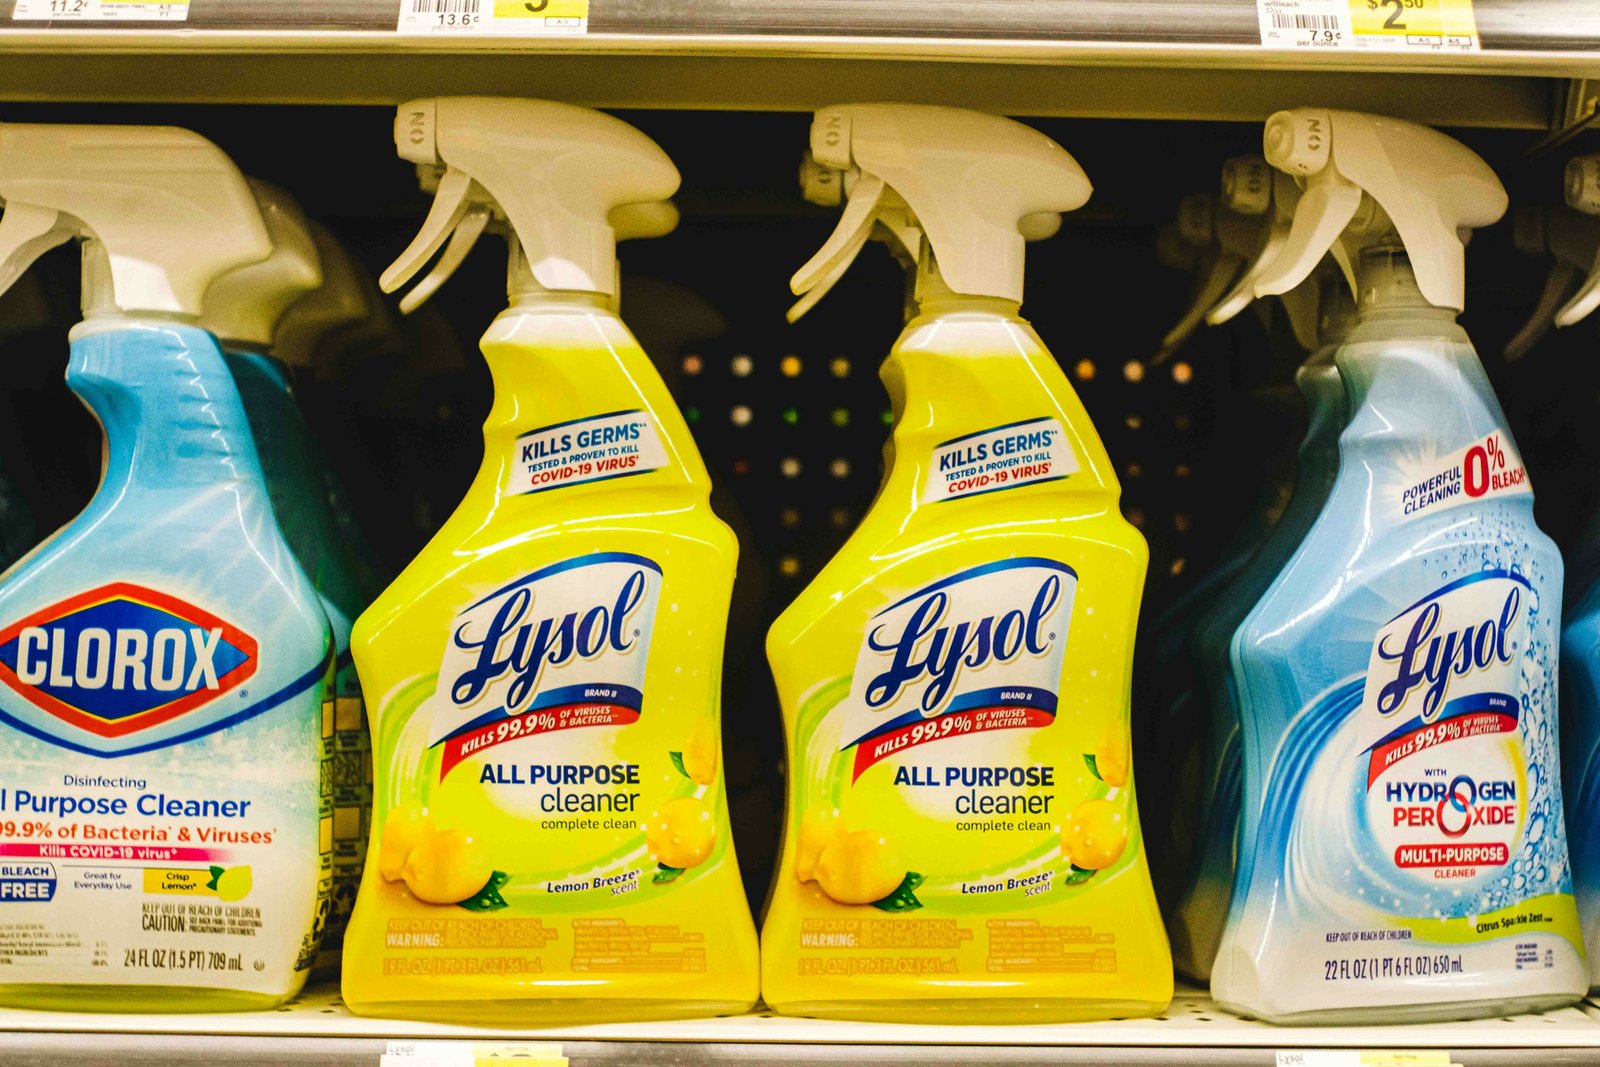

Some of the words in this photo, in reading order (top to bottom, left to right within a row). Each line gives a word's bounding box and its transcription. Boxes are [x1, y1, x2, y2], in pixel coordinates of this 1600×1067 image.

[521, 434, 571, 463] KILLS
[528, 458, 560, 473] TESTED
[570, 448, 606, 463] PROVEN
[608, 447, 620, 456] TO
[621, 444, 640, 454] KILL
[939, 443, 988, 472] KILLS
[531, 462, 593, 485] COVID-19
[945, 467, 977, 481] TESTED
[986, 457, 1020, 471] PROVEN
[1022, 454, 1033, 463] TO
[1034, 451, 1052, 461] KILL
[1463, 435, 1505, 498] 0%
[948, 471, 1008, 493] COVID-19
[1402, 466, 1462, 503] POWERFUL
[1404, 481, 1461, 515] CLEANING
[451, 570, 646, 711] Lysol
[865, 574, 1061, 713] Lysol
[16, 626, 224, 691] CLOROX
[1377, 586, 1521, 720] Lysol
[584, 689, 611, 698] BRAND
[1000, 691, 1026, 700] BRAND
[1489, 698, 1507, 707] BRAND
[560, 709, 573, 720] OF
[574, 705, 611, 717] VIRUSES
[976, 712, 988, 721] OF
[990, 708, 1026, 719] VIRUSES
[1462, 718, 1472, 727] OF
[1473, 715, 1499, 725] VIRUSES
[460, 731, 495, 758] KILLS
[496, 712, 556, 744] 99.9%
[874, 734, 909, 758] KILLS
[910, 715, 972, 746] 99.9%
[1385, 741, 1413, 766] KILLS
[1415, 721, 1461, 752] 99.9%
[63, 775, 147, 790] Disinfecting
[479, 764, 526, 785] ALL
[530, 764, 641, 785] PURPOSE
[893, 766, 940, 786] ALL
[945, 766, 1055, 787] PURPOSE
[1424, 768, 1447, 777] WITH
[15, 789, 128, 819] Purpose
[136, 793, 251, 818] Cleaner
[540, 787, 641, 813] cleaner
[955, 789, 1055, 814] cleaner
[1386, 775, 1516, 812] HYDROGEN
[541, 818, 600, 832] complete
[603, 818, 637, 830] clean
[956, 820, 1014, 832] complete
[1017, 820, 1051, 831] clean
[1393, 793, 1516, 838] PEROXIDE
[0, 821, 53, 841] 9.9%
[57, 823, 78, 840] of
[178, 827, 191, 842] &
[39, 844, 66, 857] Kills
[69, 845, 134, 858] COVID-19
[1400, 846, 1504, 864] MULTI-PURPOSE
[1, 866, 49, 876] BLEACH
[83, 872, 107, 881] Great
[109, 872, 122, 881] for
[166, 872, 190, 882] Crisp
[1434, 868, 1476, 879] CLEANER
[1, 882, 50, 899] FREE
[74, 881, 114, 891] Everyday
[117, 882, 132, 890] Use
[546, 880, 589, 894] Lemon
[610, 880, 638, 896] scent
[961, 882, 1003, 894] Lemon
[1025, 882, 1050, 897] scent
[142, 903, 159, 914] KEEP
[162, 904, 176, 914] OUT
[178, 904, 187, 915] OF
[188, 905, 213, 916] REACH
[214, 906, 223, 917] OF
[225, 907, 261, 919] CHILDREN
[1476, 920, 1500, 934] Citrus
[1500, 915, 1527, 929] Sparkle
[1528, 913, 1543, 923] Zest
[801, 933, 859, 948] WARNING:
[1326, 933, 1340, 943] KEEP
[1340, 932, 1351, 942] OUT
[1352, 932, 1360, 941] OF
[1360, 931, 1377, 941] REACH
[1378, 931, 1386, 940] OF
[1387, 930, 1412, 940] CHILDREN
[124, 949, 136, 967] 24
[139, 949, 149, 967] FL
[152, 949, 166, 968] OZ
[168, 950, 186, 970] (1.5
[188, 951, 205, 971] PT)
[208, 952, 226, 971] 709
[228, 954, 244, 971] mL
[1325, 960, 1338, 980] 22
[1340, 960, 1351, 980] FL
[1353, 959, 1367, 979] OZ
[1369, 958, 1379, 980] (1
[1382, 957, 1394, 978] PT
[1395, 957, 1401, 976] 6
[1404, 957, 1414, 976] FL
[1415, 955, 1432, 977] OZ)
[1433, 955, 1450, 974] 650
[1451, 954, 1464, 973] mL
